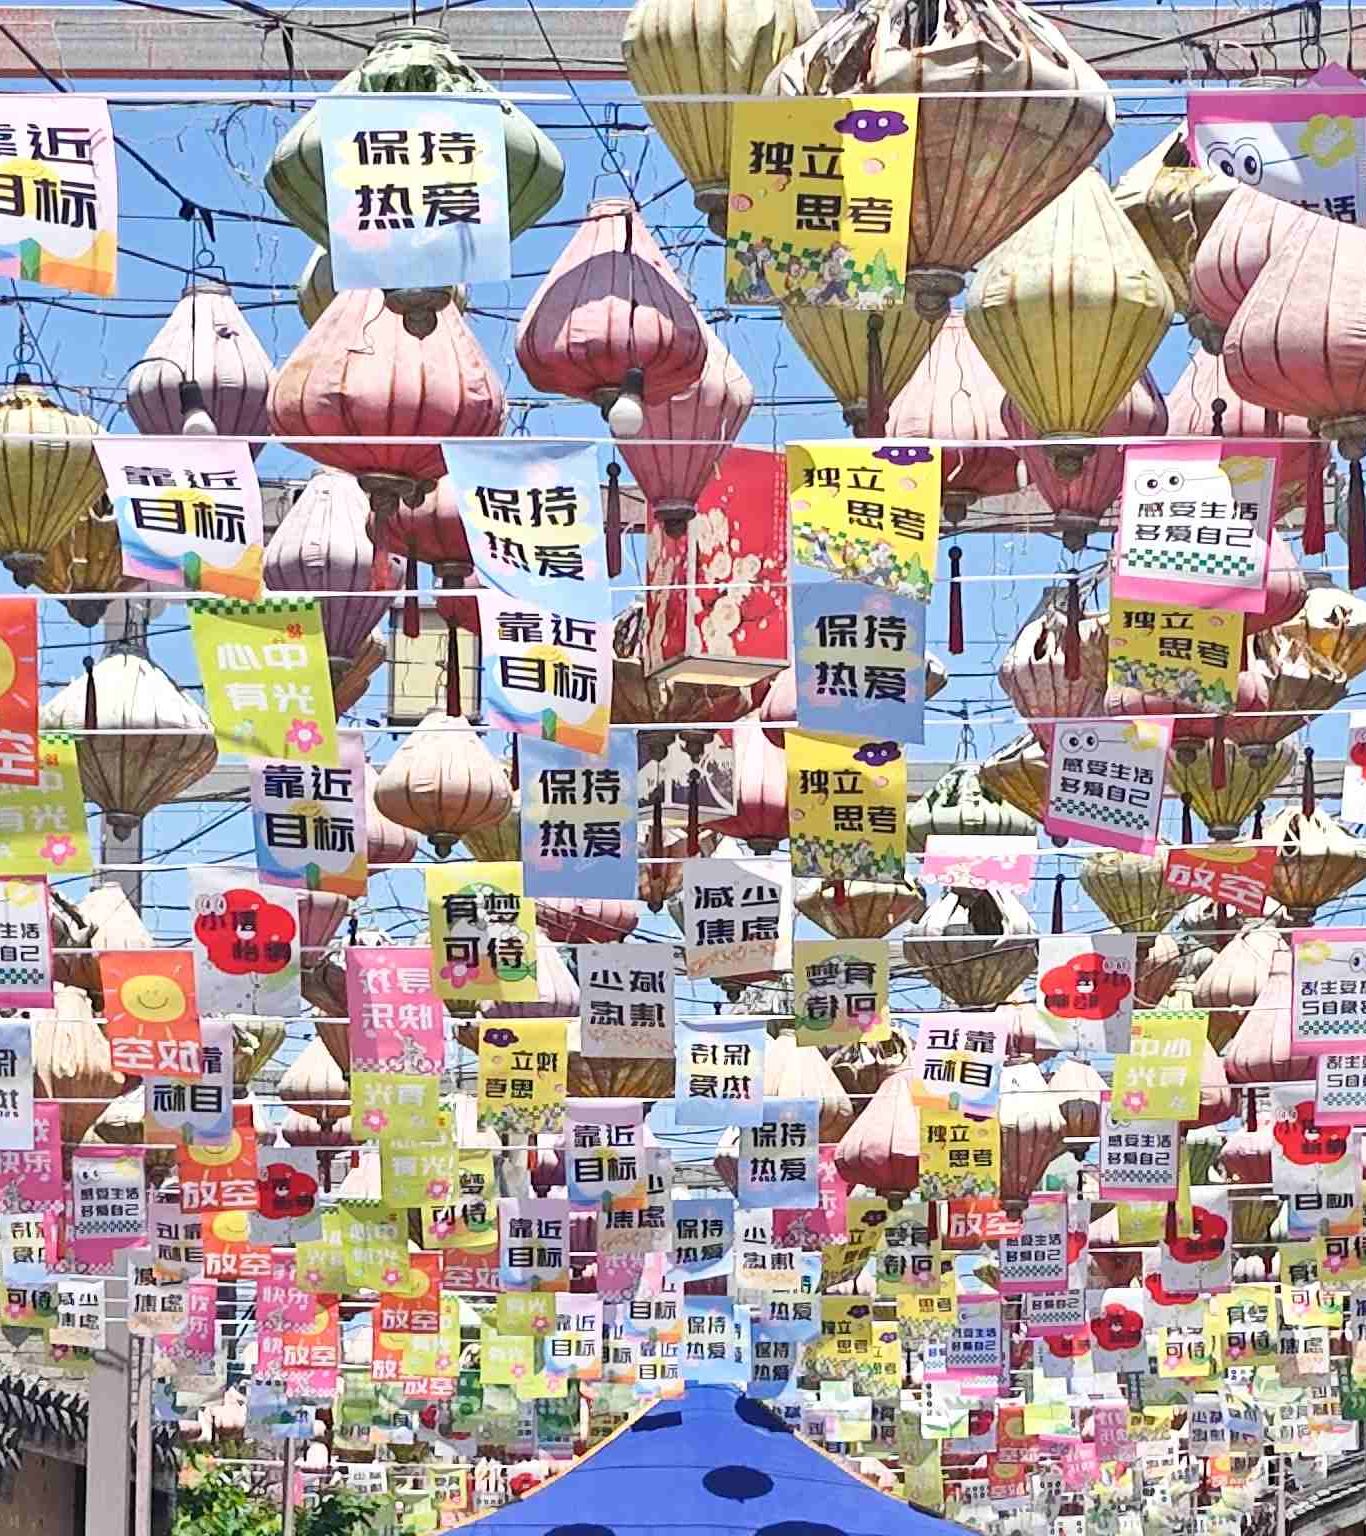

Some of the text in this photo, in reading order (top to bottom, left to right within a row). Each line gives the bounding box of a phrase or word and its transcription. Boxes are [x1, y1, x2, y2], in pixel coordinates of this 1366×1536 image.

[350, 127, 478, 168] 保持
[749, 140, 845, 180] 独立
[355, 181, 482, 232] 热爱
[795, 192, 894, 235] 思考
[121, 464, 243, 492] 靠近
[803, 464, 885, 494] 独立
[472, 484, 578, 529] 保持
[846, 499, 926, 542] 思考
[1137, 500, 1259, 524] 感受生活
[132, 497, 247, 546] 目标
[1135, 523, 1256, 549] 多爱自己
[485, 530, 585, 582] 热爱
[495, 612, 597, 652] 靠近
[815, 613, 905, 652] 保持
[1123, 610, 1194, 633] 独立
[218, 642, 310, 671] 心中
[1158, 637, 1230, 669] 思考
[499, 656, 597, 705] 目标
[815, 663, 906, 703] 热爱
[225, 682, 317, 715] 有光
[262, 764, 352, 802] 靠近
[800, 768, 863, 796] 独立
[1062, 757, 1153, 785] 感受生活
[538, 768, 621, 806] 保持
[1060, 777, 1150, 808] 多爱自己
[265, 813, 355, 852] 目标
[833, 805, 897, 834] 思考
[540, 822, 622, 858] 热爱
[694, 886, 779, 911] 减少
[1168, 863, 1264, 910] 放空
[442, 892, 520, 929] 有梦
[696, 917, 780, 946] 焦虑
[445, 935, 522, 968] 可待
[573, 1125, 634, 1148] 靠近
[752, 1122, 806, 1147] 保持
[927, 1124, 970, 1143] 独立
[1108, 1134, 1171, 1149] 感受生活
[574, 1159, 636, 1183] 目标
[751, 1157, 806, 1182] 热爱
[949, 1149, 993, 1168] 思考
[1108, 1152, 1170, 1167] 多爱自己
[80, 1187, 139, 1201] 感受生活
[182, 1180, 258, 1209] 放空
[81, 1204, 139, 1218] 多爱自己
[509, 1219, 562, 1239] 靠近
[676, 1219, 724, 1239] 保持
[205, 1254, 273, 1276] 放空
[509, 1248, 562, 1267] 目标
[382, 1309, 440, 1331] 放空
[552, 1339, 594, 1357] 目标
